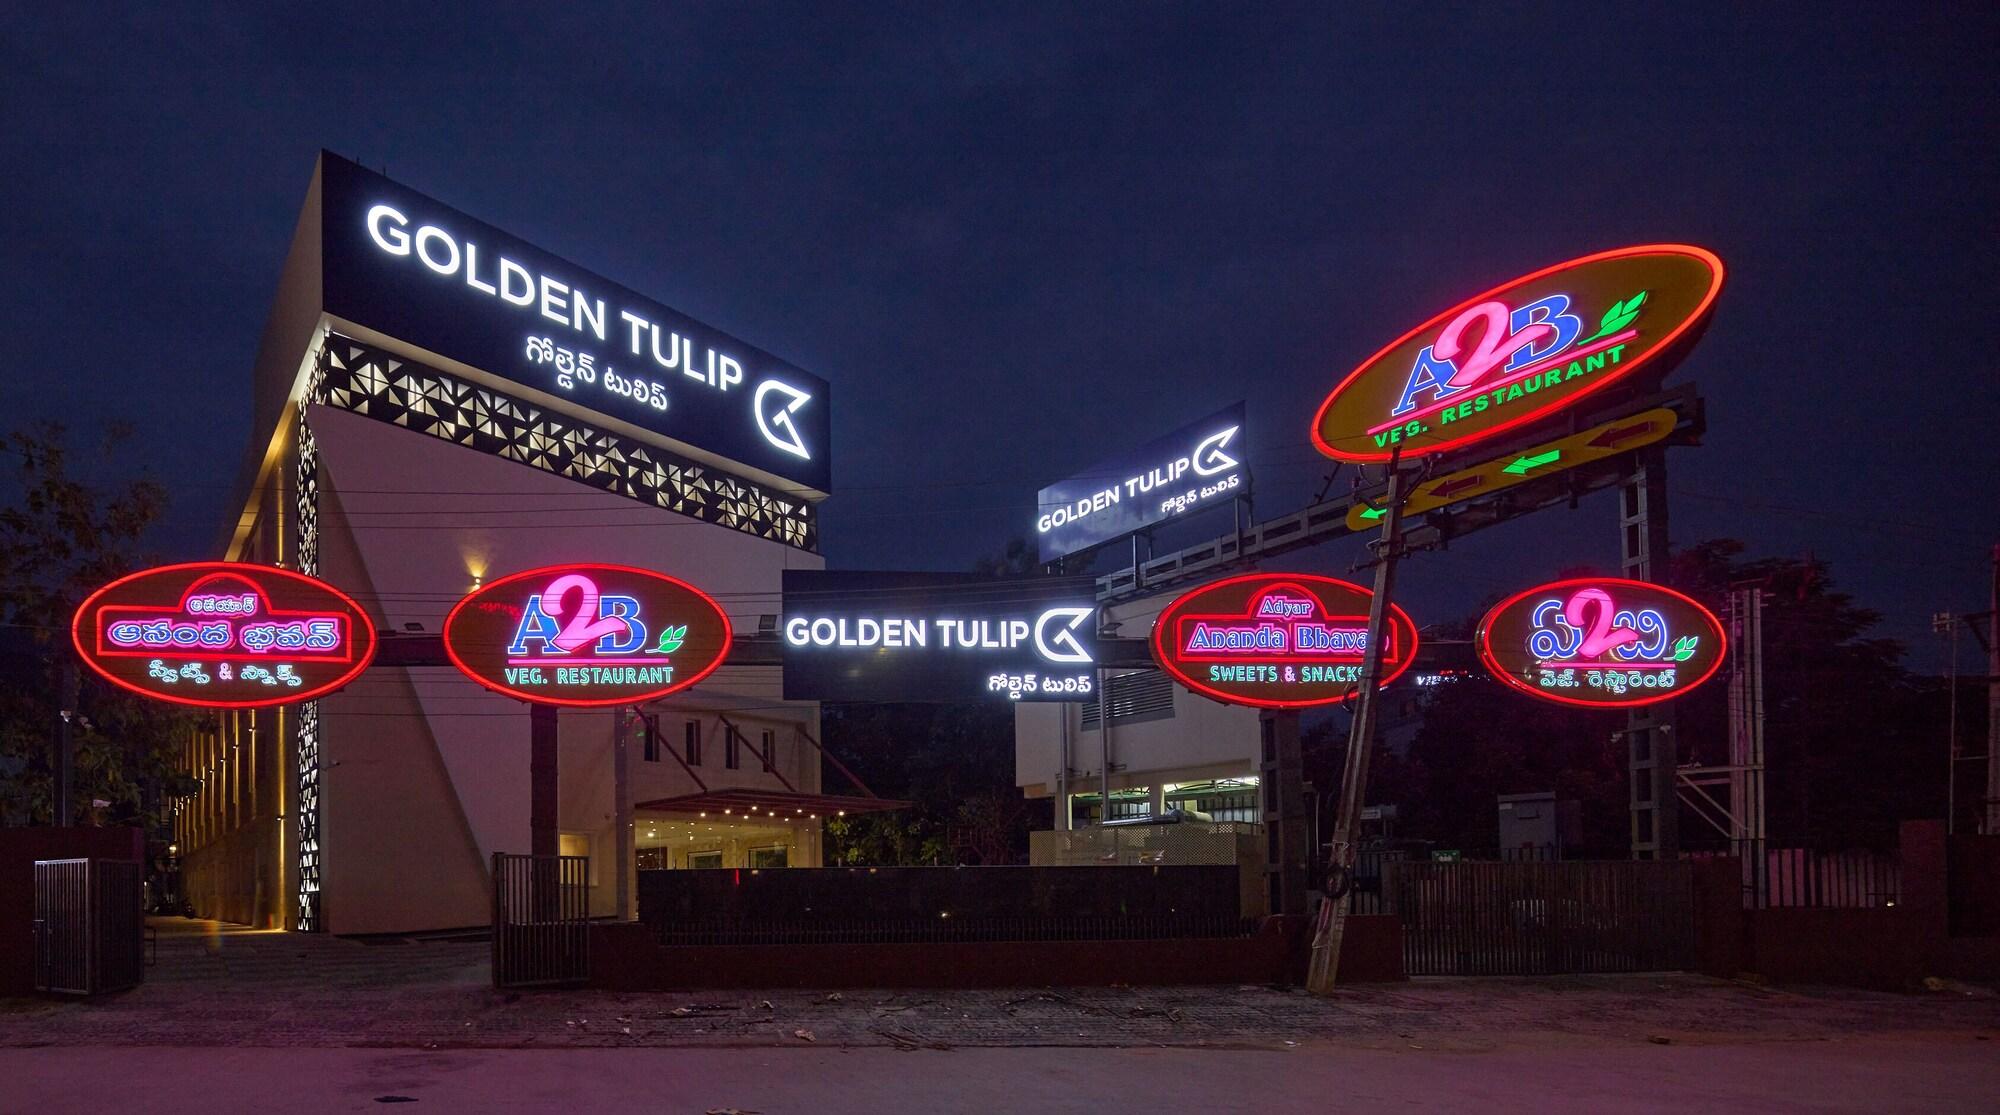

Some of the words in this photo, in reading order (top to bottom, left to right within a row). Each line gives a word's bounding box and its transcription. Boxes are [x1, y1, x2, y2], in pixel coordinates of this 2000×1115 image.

[366, 204, 606, 341] GOLDEN
[620, 310, 744, 392] TULIP
[1392, 294, 1582, 416] A2B
[526, 335, 597, 390] గోల్డెన్
[604, 366, 669, 411] టులిప్
[1374, 420, 1428, 448] VEG.
[1441, 344, 1625, 425] RESTAURANT
[1037, 485, 1121, 533] GOLDEN
[1125, 457, 1190, 498] TULIP
[508, 574, 647, 656] A2B
[1261, 599, 1311, 617] Adyar
[111, 622, 230, 646] ఆనంద
[243, 621, 337, 650] భవన్
[785, 617, 927, 647] GOLDEN
[935, 619, 1030, 648] TULIP
[1191, 625, 1285, 649] Ananda
[1296, 626, 1368, 649] Bhava
[219, 662, 233, 681] &
[505, 667, 548, 685] VEG.
[556, 666, 674, 685] RESTAURANT
[988, 673, 1037, 699] గోల్డెన్
[1042, 676, 1092, 694] టులిప్
[1210, 665, 1278, 683] SWEETS
[1283, 666, 1296, 682] &
